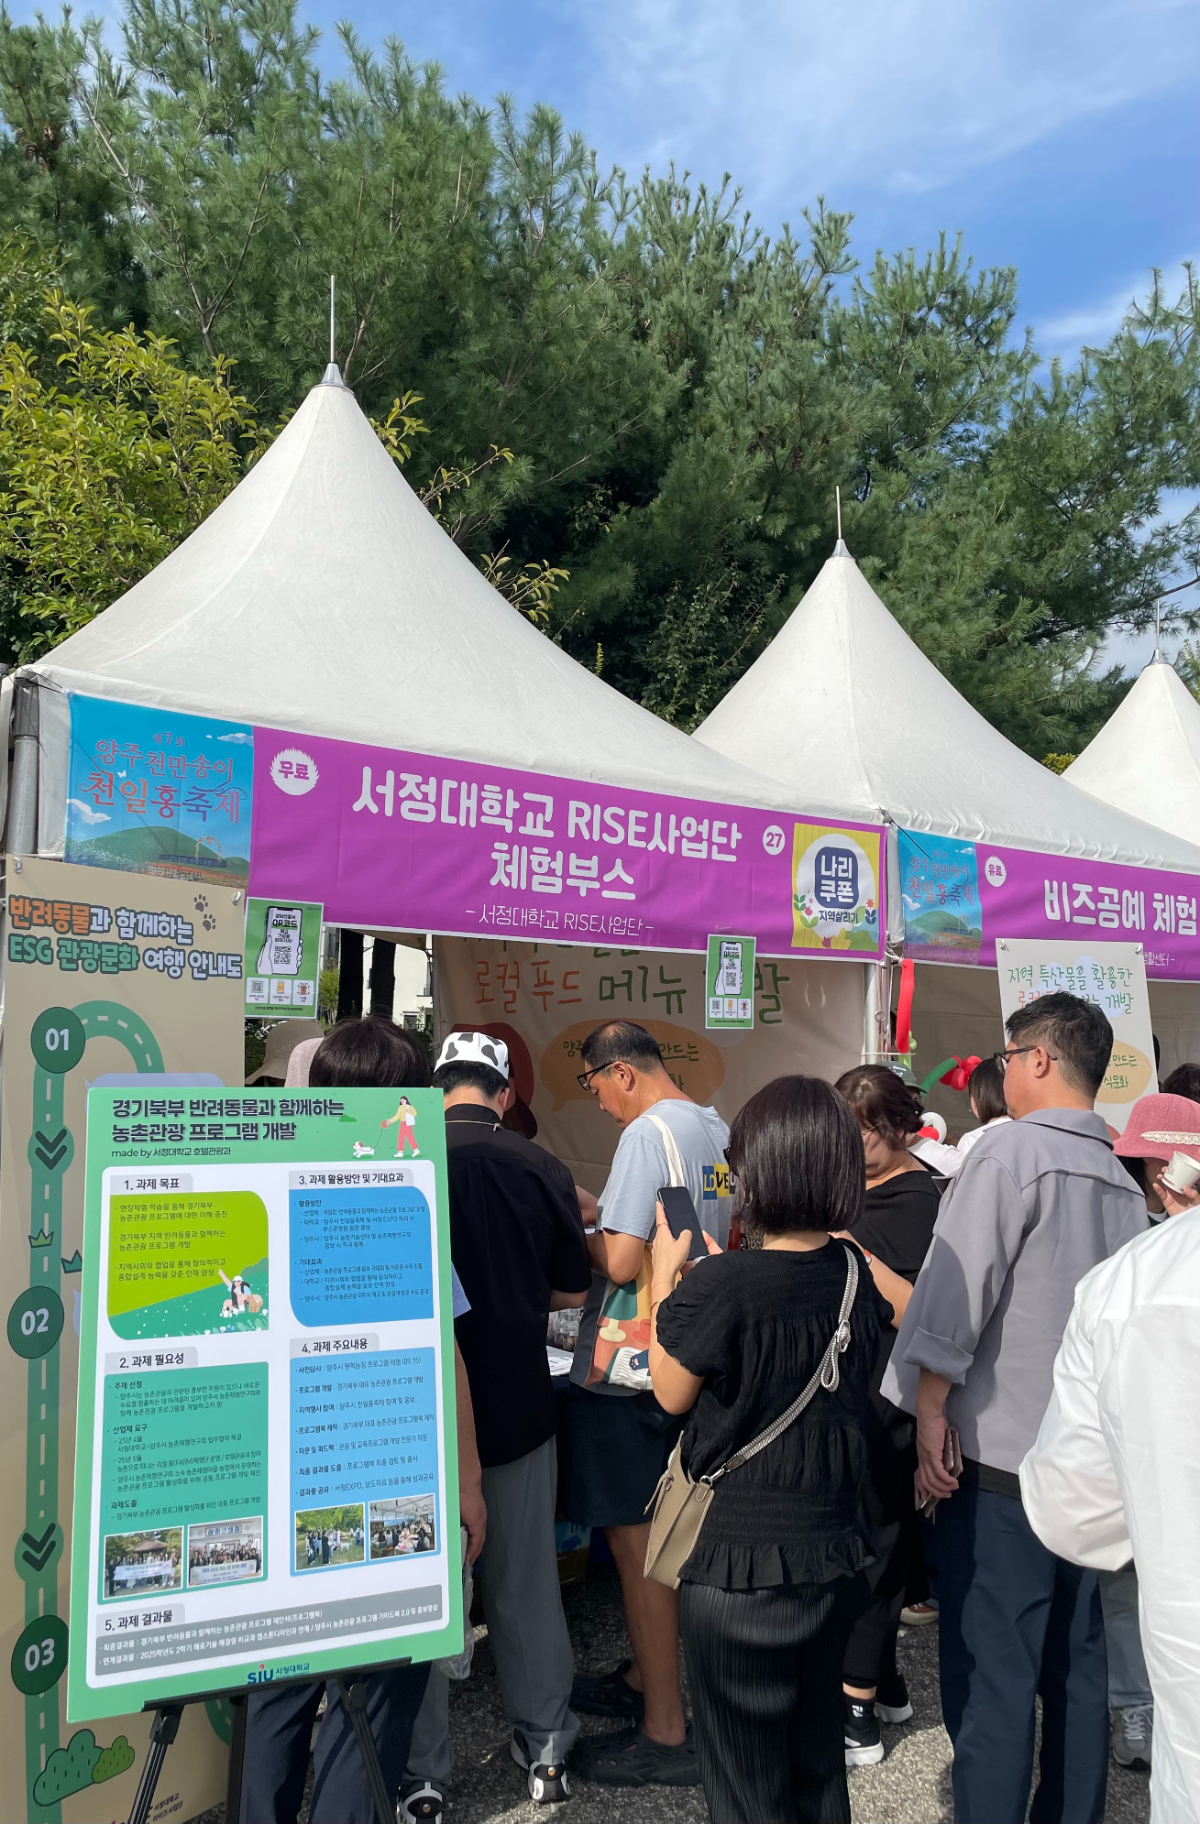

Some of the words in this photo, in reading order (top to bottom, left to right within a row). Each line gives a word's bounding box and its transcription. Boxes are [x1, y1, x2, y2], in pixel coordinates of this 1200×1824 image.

[278, 761, 309, 781] 무료
[352, 766, 555, 838] 서정대학교
[567, 800, 742, 862] RISE사업단
[765, 832, 783, 847] 27
[489, 842, 636, 900] 체험부스
[820, 854, 853, 879] 나리
[988, 864, 1002, 876] 유료
[820, 879, 854, 903] 쿠폰
[1044, 879, 1146, 930] 비즈공예
[1153, 893, 1197, 936] 체험
[8, 894, 112, 935] 반려동물과
[115, 907, 193, 945] 함께하는
[478, 904, 559, 932] 서정대학교
[564, 912, 642, 937] RISE사업단
[819, 910, 858, 923] 지역살리기
[9, 933, 53, 964] ESG
[57, 937, 140, 974] 관광문화
[143, 946, 185, 979] 여행
[188, 950, 243, 980] 안내도
[1008, 965, 1033, 987] 지역
[1039, 965, 1087, 990] 특산물을
[1092, 964, 1133, 990] 활용한
[475, 960, 520, 1014] 로컬
[531, 960, 582, 1013] 푸드
[599, 965, 687, 1015] 메뉴
[1106, 992, 1134, 1014] 개발
[45, 1028, 69, 1051] 01
[659, 1043, 699, 1062] 만드는
[1112, 1054, 1137, 1066] 만드는
[112, 1099, 185, 1118] 경기북부
[189, 1099, 276, 1117] 반려동물과
[279, 1098, 345, 1116] 함께하는
[111, 1124, 185, 1142] 농촌관광
[189, 1123, 259, 1140] 프로그램
[263, 1122, 297, 1140] 개발
[112, 1149, 139, 1157] made
[140, 1149, 151, 1159] by
[153, 1148, 192, 1157] 서정대학교
[193, 1147, 231, 1156] 호텔관광과
[124, 1180, 134, 1190] 1.
[136, 1179, 157, 1190] 과제
[159, 1178, 180, 1189] 목표
[299, 1176, 307, 1185] 3.
[309, 1175, 325, 1185] 과제
[328, 1174, 360, 1184] 활용방안
[363, 1174, 370, 1183] 및
[372, 1173, 404, 1183] 기대효과
[120, 1204, 147, 1212] 현장체험
[120, 1214, 146, 1222] 농촌관광
[120, 1233, 146, 1241] 경기북부
[164, 1231, 197, 1239] 반려동물과
[200, 1230, 225, 1238] 함께하는
[119, 1243, 146, 1251] 농촌관광
[119, 1262, 152, 1270] 지역사회와
[156, 1261, 175, 1269] 협업을
[178, 1260, 190, 1268] 통해
[193, 1259, 225, 1267] 창의적이고
[118, 1273, 145, 1281] 종합설계
[148, 1271, 167, 1279] 능력을
[20, 1308, 50, 1336] 02
[302, 1343, 311, 1353] 4.
[313, 1341, 330, 1352] 과제
[333, 1338, 368, 1351] 주요내용
[119, 1358, 129, 1368] 2.
[132, 1356, 152, 1367] 과제
[155, 1353, 184, 1366] 필요성
[129, 1381, 142, 1389] 선정
[113, 1425, 132, 1434] 산업체
[135, 1424, 148, 1432] 요구
[111, 1499, 137, 1509] 과제도출
[105, 1620, 115, 1631] 5.
[118, 1617, 138, 1629] 과제
[142, 1610, 173, 1626] 결과물
[24, 1639, 55, 1671] 03
[276, 1663, 309, 1674] 서정대학교
